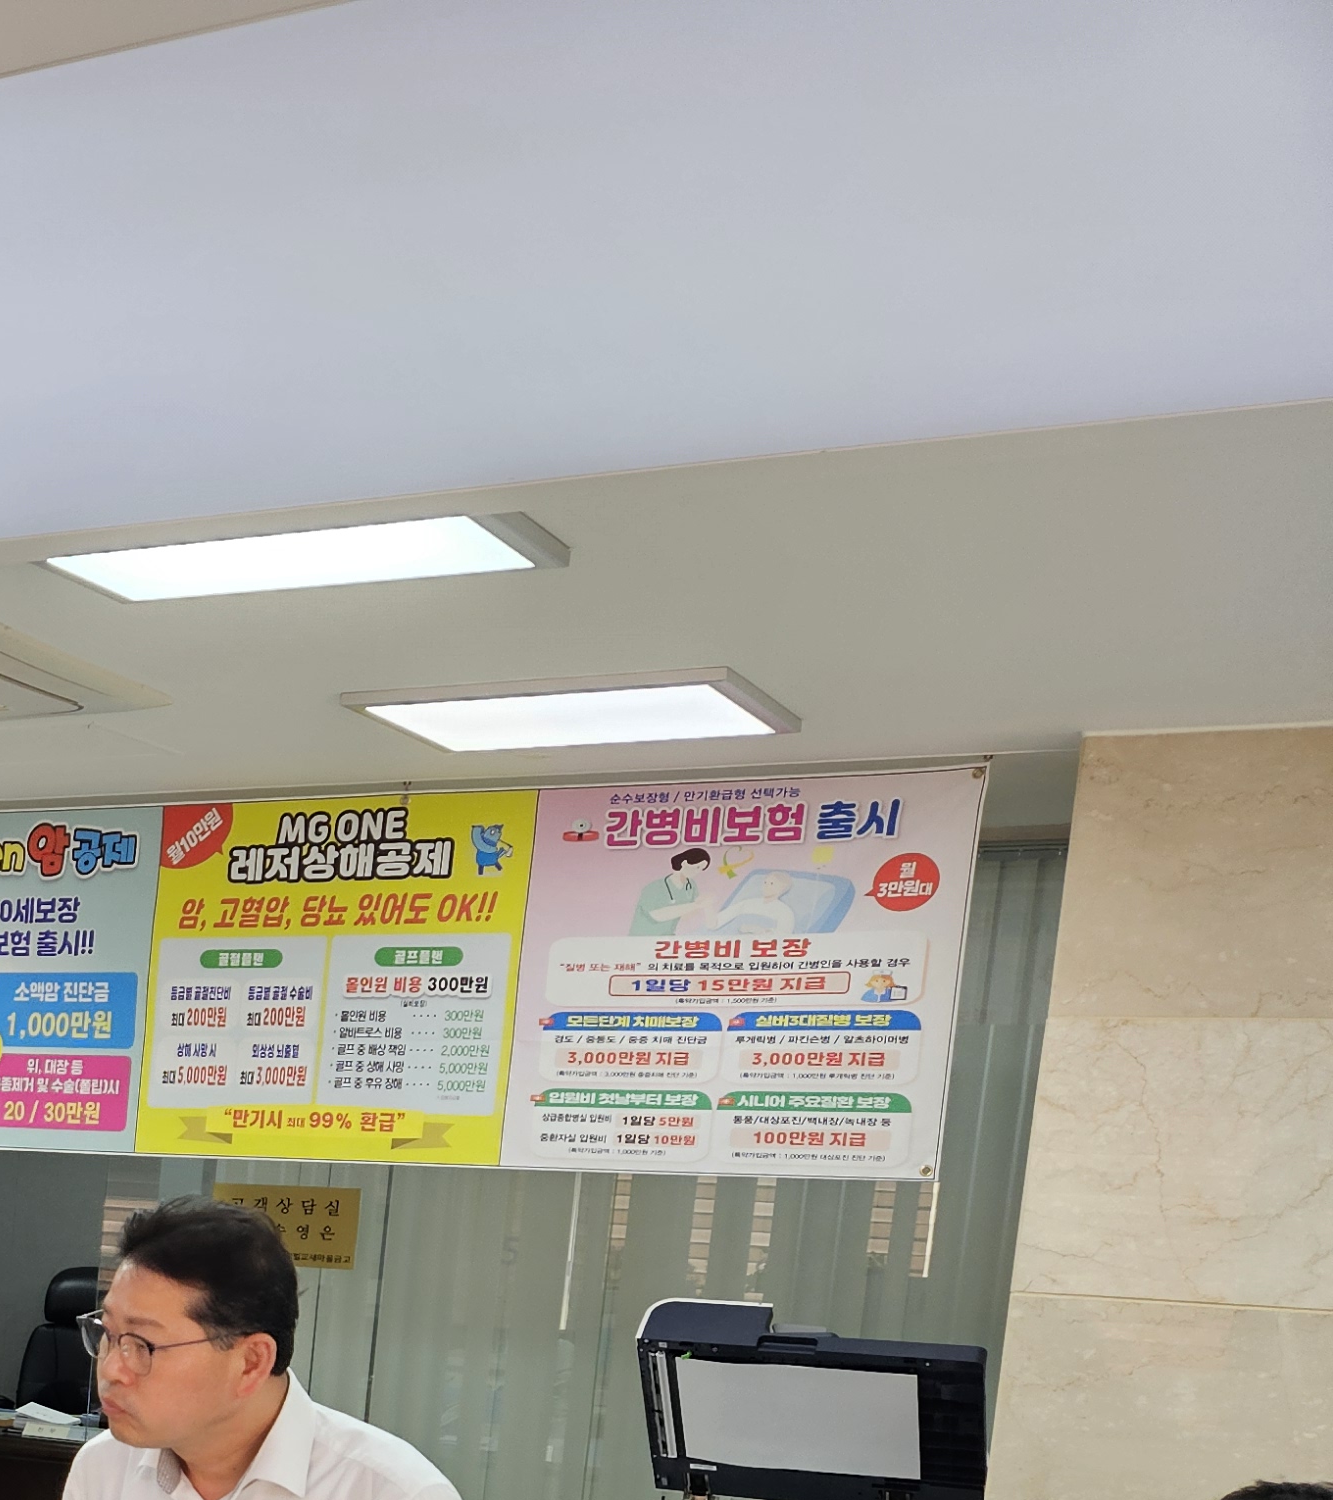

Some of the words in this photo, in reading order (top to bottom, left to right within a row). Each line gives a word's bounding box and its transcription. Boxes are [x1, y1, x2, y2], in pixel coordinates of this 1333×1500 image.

[609, 791, 670, 805] 순수보장형
[684, 789, 746, 803] 만기환급형
[750, 787, 800, 800] 선택가능
[279, 813, 330, 845] MG
[337, 809, 406, 842] ONE
[605, 803, 805, 848] 간병비보험
[817, 798, 903, 840] 출시
[27, 822, 71, 877] 암
[72, 828, 137, 876] 공제
[229, 839, 453, 882] 레저상해공제
[899, 861, 916, 877] 월
[877, 878, 933, 897] 3만원대
[179, 898, 208, 931] 암,
[213, 897, 291, 930] 고혈압,
[300, 895, 349, 926] 당뇨
[354, 892, 431, 925] 있어도
[437, 891, 499, 922] OK!!
[36, 929, 95, 958] 출시!!
[654, 940, 741, 959] 간병비
[750, 938, 811, 957] 보장
[14, 982, 60, 1003] 소액암
[63, 982, 110, 1003] 진단금
[394, 977, 422, 993] 비용
[428, 976, 488, 993] 300만원
[632, 979, 690, 993] 1일당
[697, 978, 773, 992] 15만원
[779, 977, 825, 992] 지급
[7, 1010, 112, 1040] 1,000만원
[171, 1013, 185, 1027] 최대
[187, 1007, 227, 1027] 200만원
[247, 1012, 261, 1026] 최대
[263, 1006, 306, 1027] 200만원
[854, 1014, 892, 1027] 보장
[567, 1052, 651, 1066] 3,000만원
[656, 1052, 689, 1066] 지급
[752, 1052, 842, 1067] 3,000만원
[847, 1052, 885, 1067] 지급
[549, 1092, 595, 1105] 입원비
[664, 1094, 699, 1106] 보장
[737, 1095, 785, 1107] 시니어
[857, 1097, 891, 1109] 보장
[3, 1101, 25, 1121] 20
[44, 1101, 101, 1125] 30만원
[622, 1116, 655, 1126] 1일당
[659, 1116, 694, 1127] 5만원
[617, 1134, 650, 1144] 1일당
[654, 1135, 695, 1146] 10만원
[753, 1131, 824, 1146] 100만원
[829, 1133, 866, 1146] 지급
